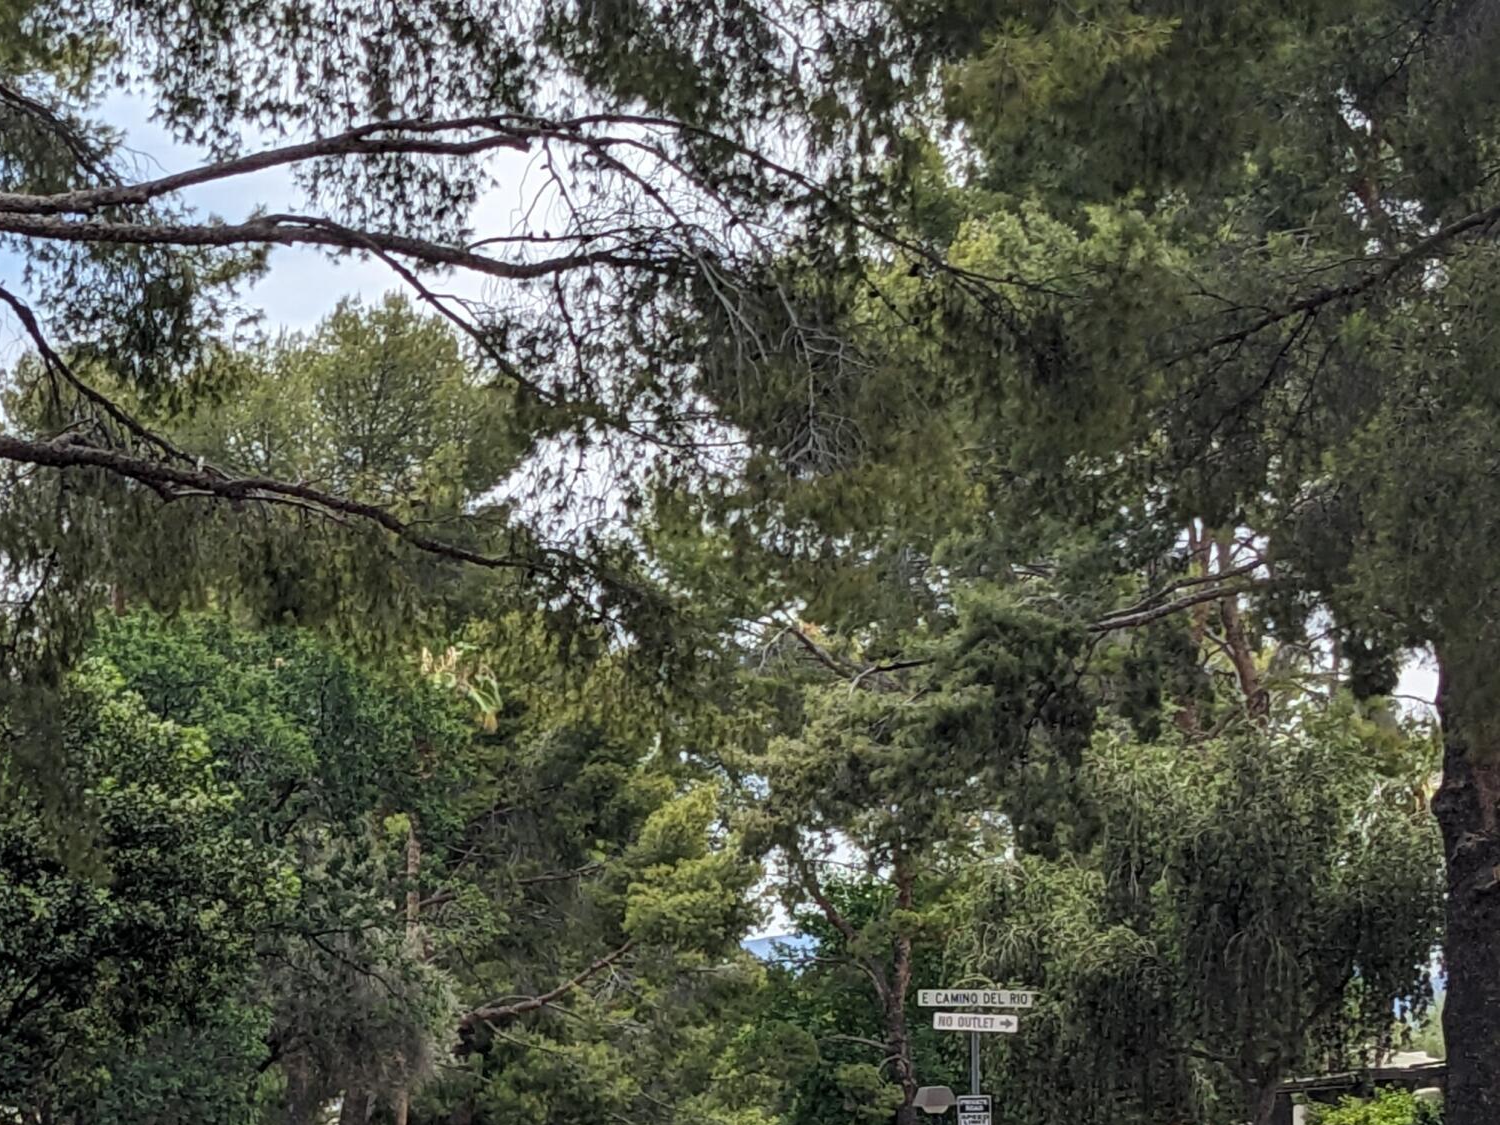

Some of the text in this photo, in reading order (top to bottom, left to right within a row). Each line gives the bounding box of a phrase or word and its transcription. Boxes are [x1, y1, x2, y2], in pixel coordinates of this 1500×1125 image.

[922, 992, 1028, 1006] E CAMINO DEL RIO
[938, 1015, 995, 1029] NO OUTLET
